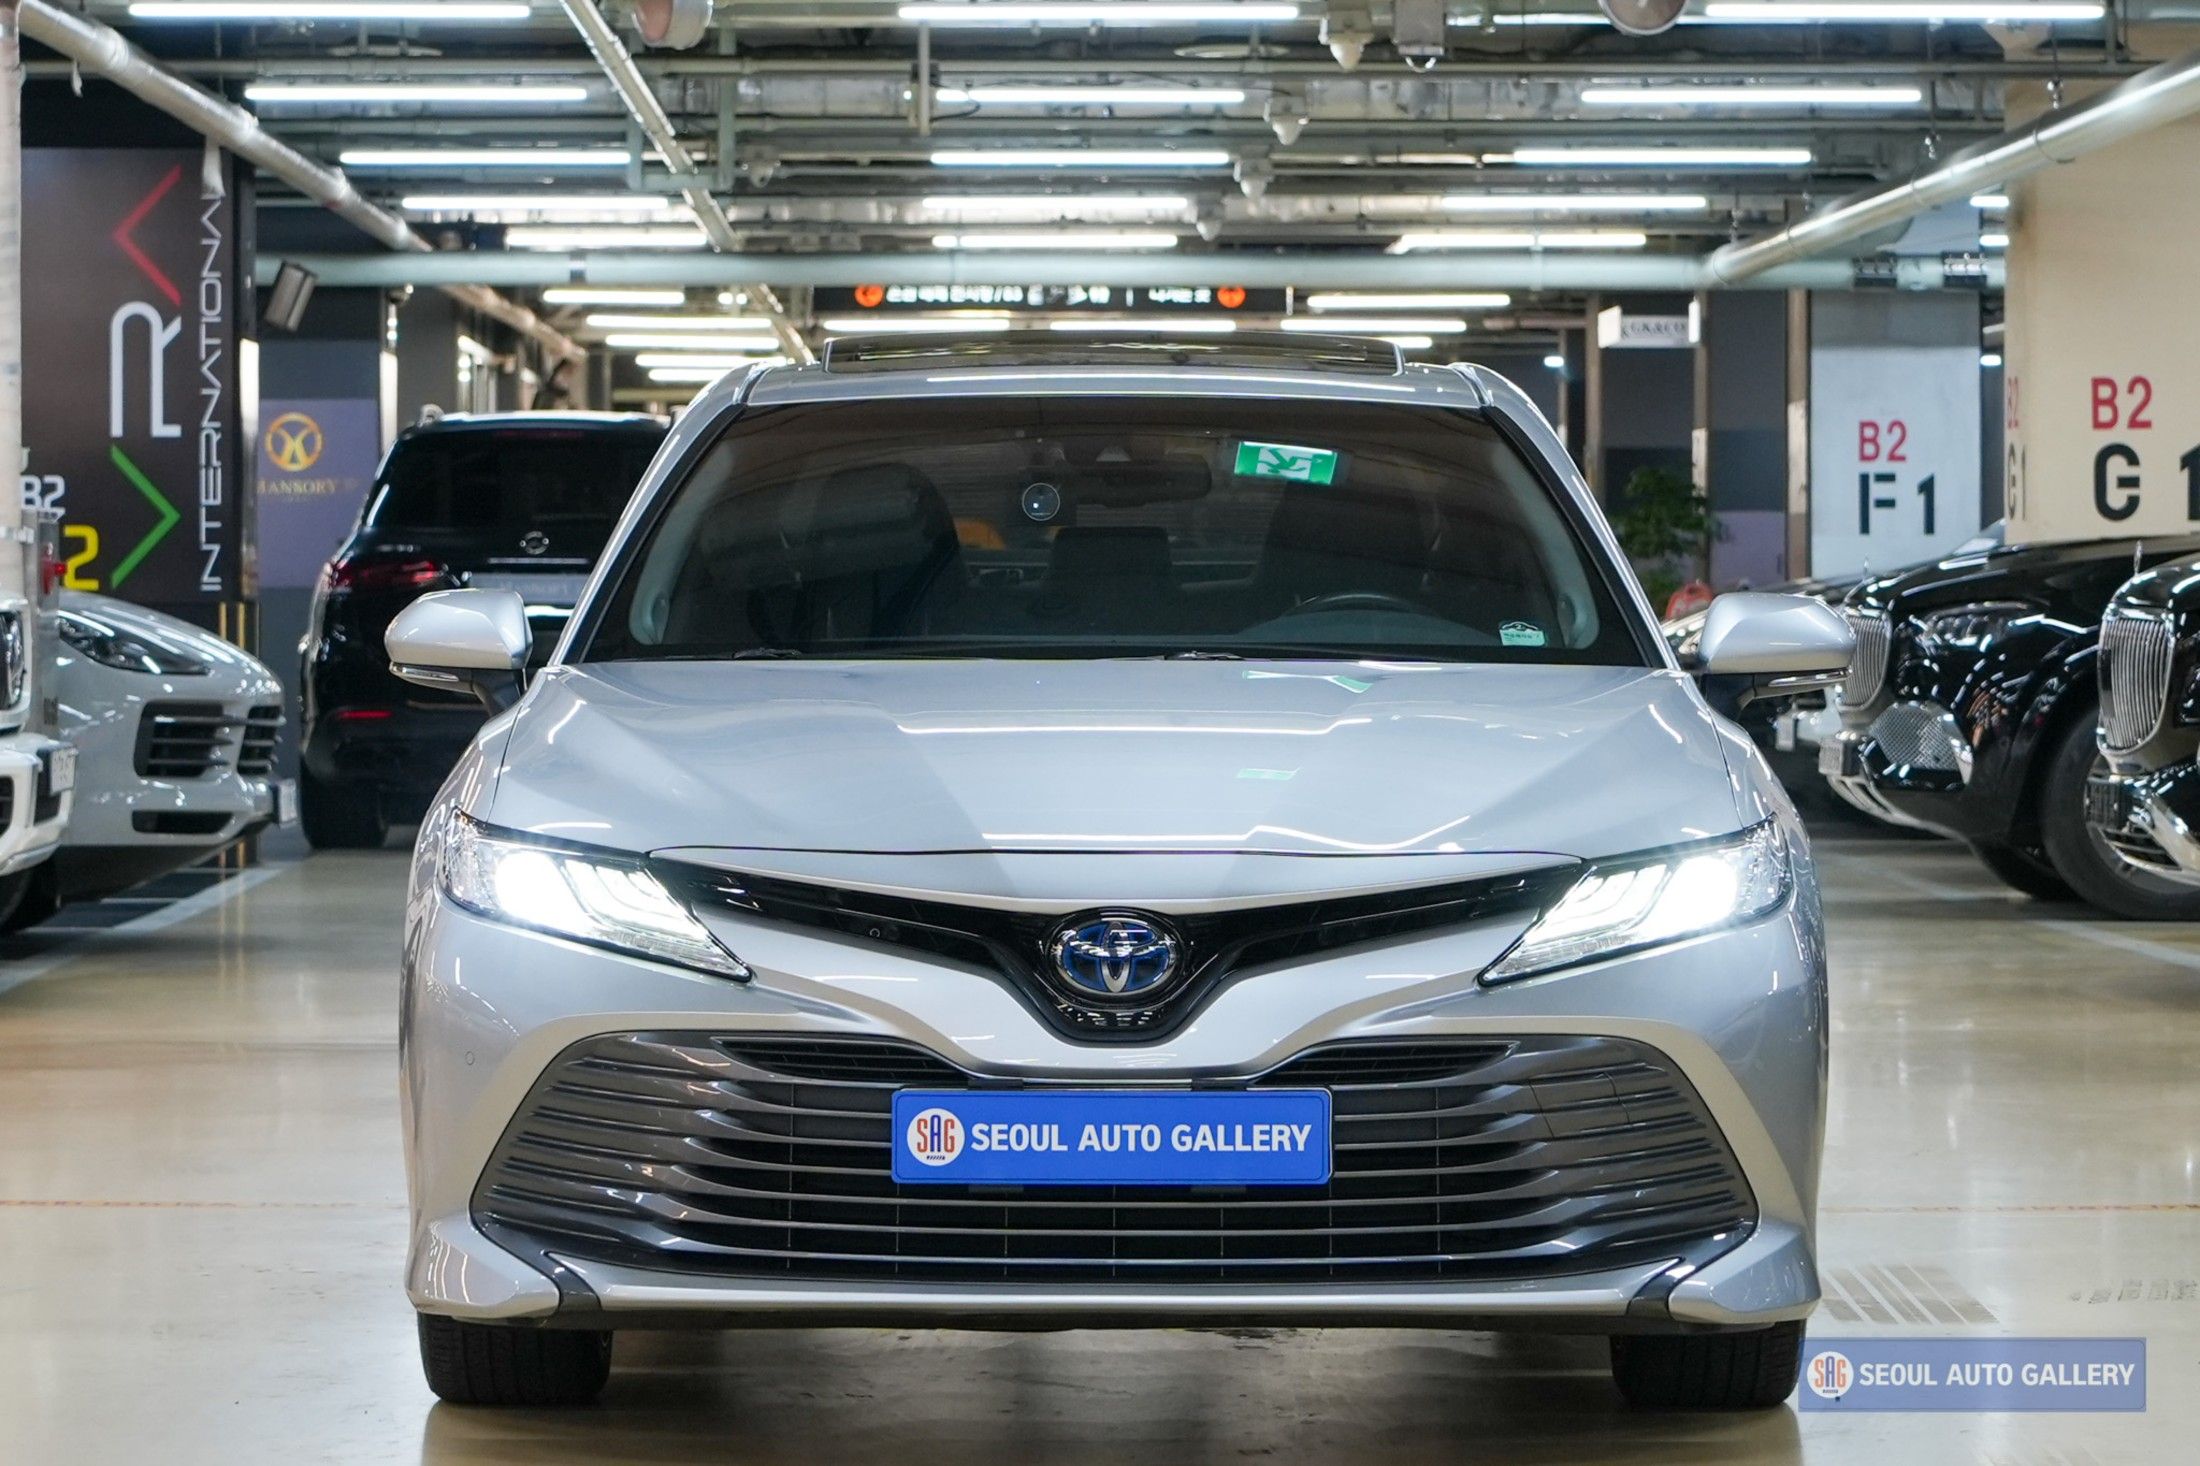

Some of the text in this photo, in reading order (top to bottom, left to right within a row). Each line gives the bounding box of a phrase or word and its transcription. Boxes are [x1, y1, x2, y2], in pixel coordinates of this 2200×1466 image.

[2091, 375, 2152, 430] B2
[1859, 420, 1906, 462] B2
[20, 474, 66, 511] B2
[916, 1114, 1313, 1153] SAG SEOUL AUTO GALLERY
